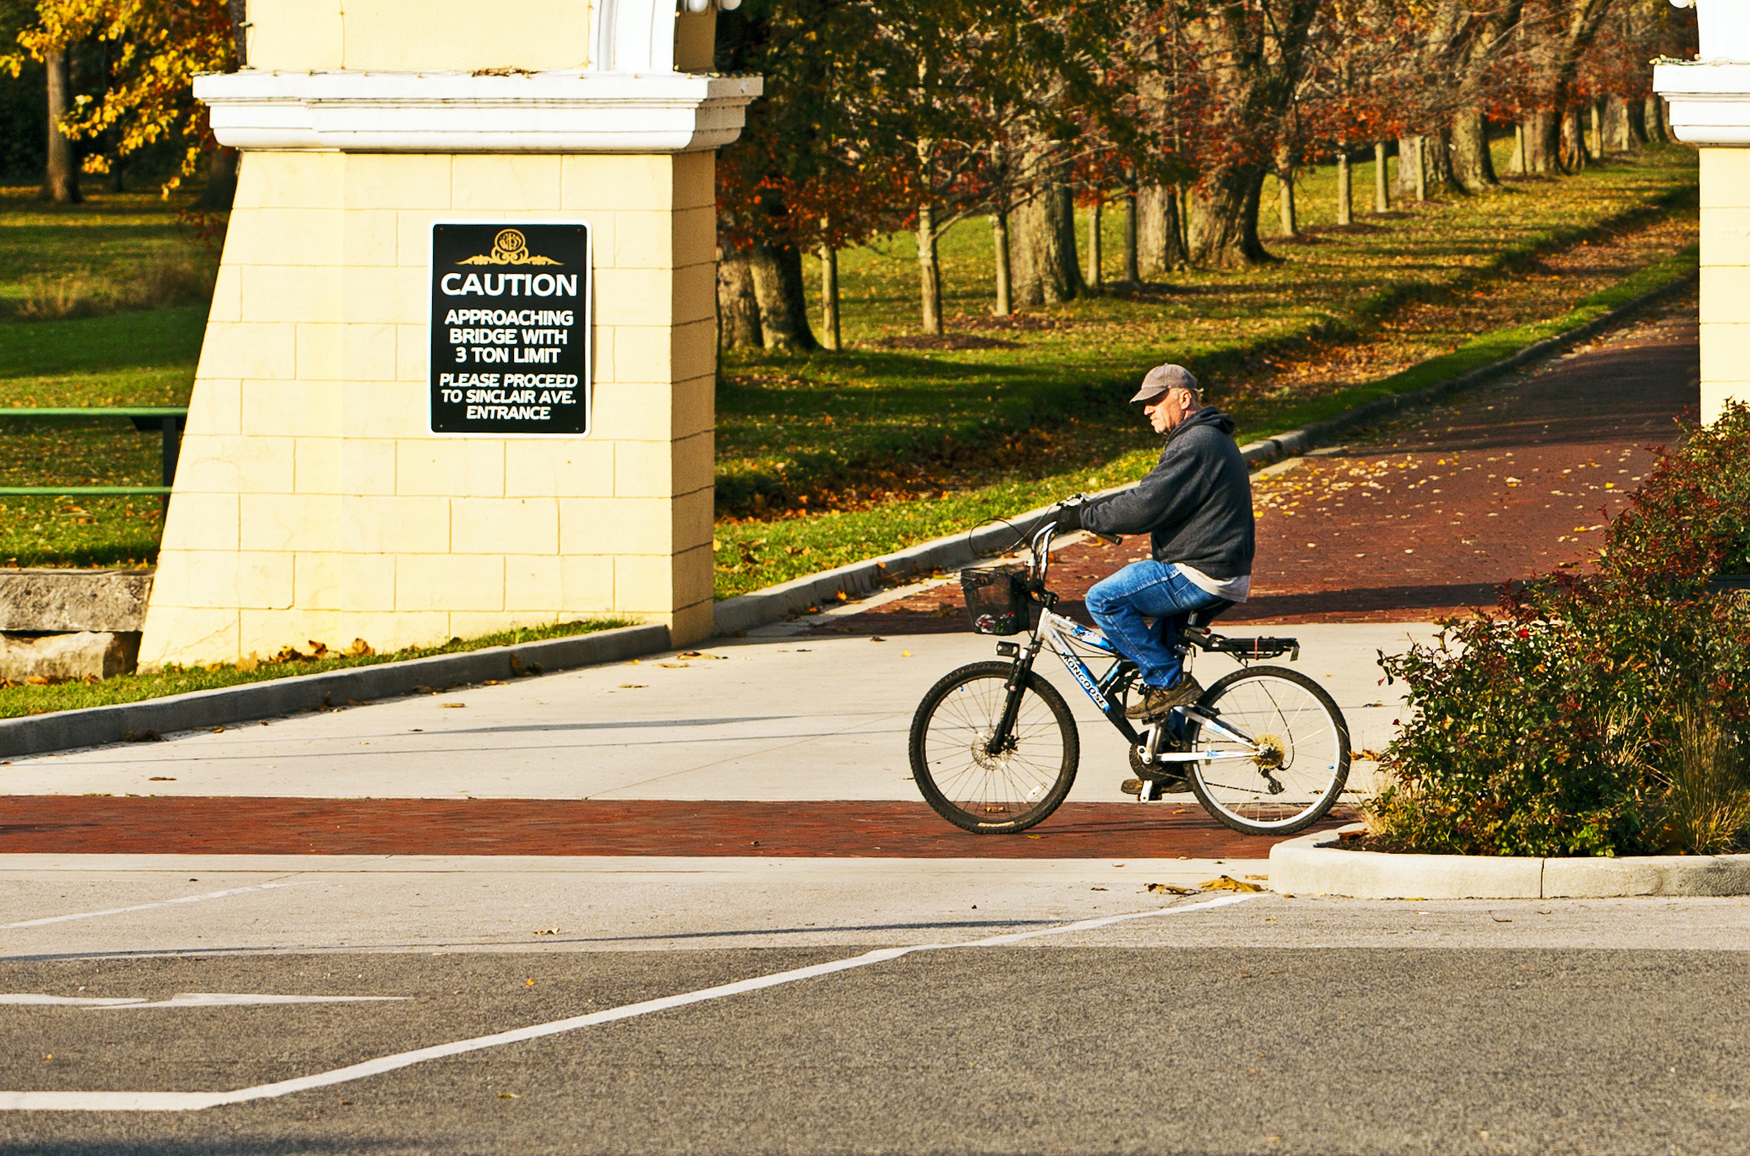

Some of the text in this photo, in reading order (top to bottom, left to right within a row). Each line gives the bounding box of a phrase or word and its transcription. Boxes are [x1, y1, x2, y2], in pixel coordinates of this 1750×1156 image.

[440, 273, 578, 296] CAUTION
[444, 309, 574, 326] APPROACHING
[449, 328, 568, 345] BRIDGE WITH
[455, 347, 562, 363] 3 TON LIMIT
[439, 373, 579, 388] PLEASE PROCEED
[440, 389, 577, 404] TO SINCLAIR AVE.
[466, 405, 552, 420] ENTRANCE
[1061, 651, 1108, 707] MONGOOSE
